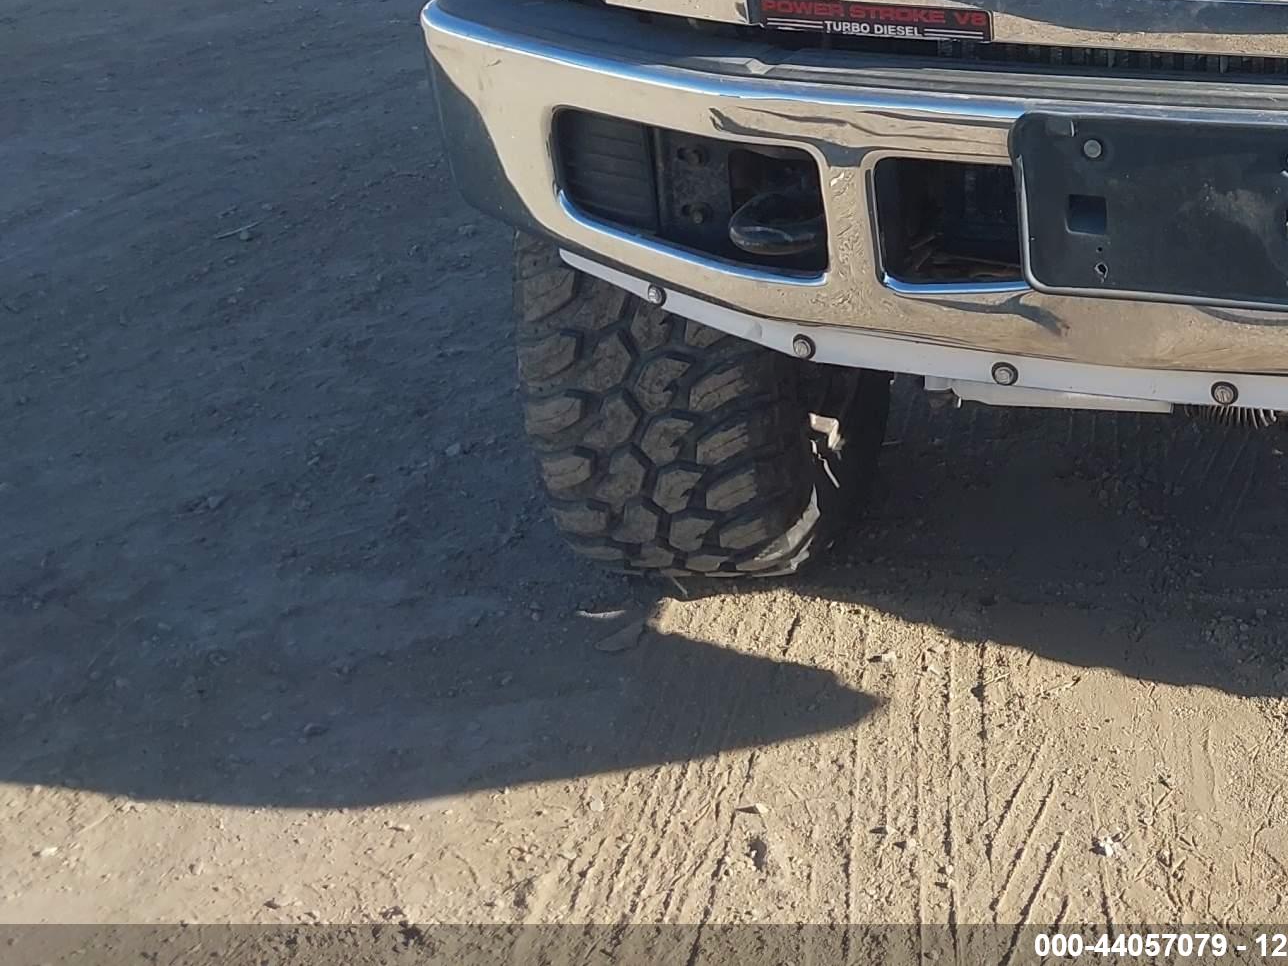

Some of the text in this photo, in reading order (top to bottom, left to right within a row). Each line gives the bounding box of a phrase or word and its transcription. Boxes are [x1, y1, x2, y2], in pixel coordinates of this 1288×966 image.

[762, 0, 987, 27] POWER STROKE V8
[824, 20, 923, 36] TURBO DIESEL
